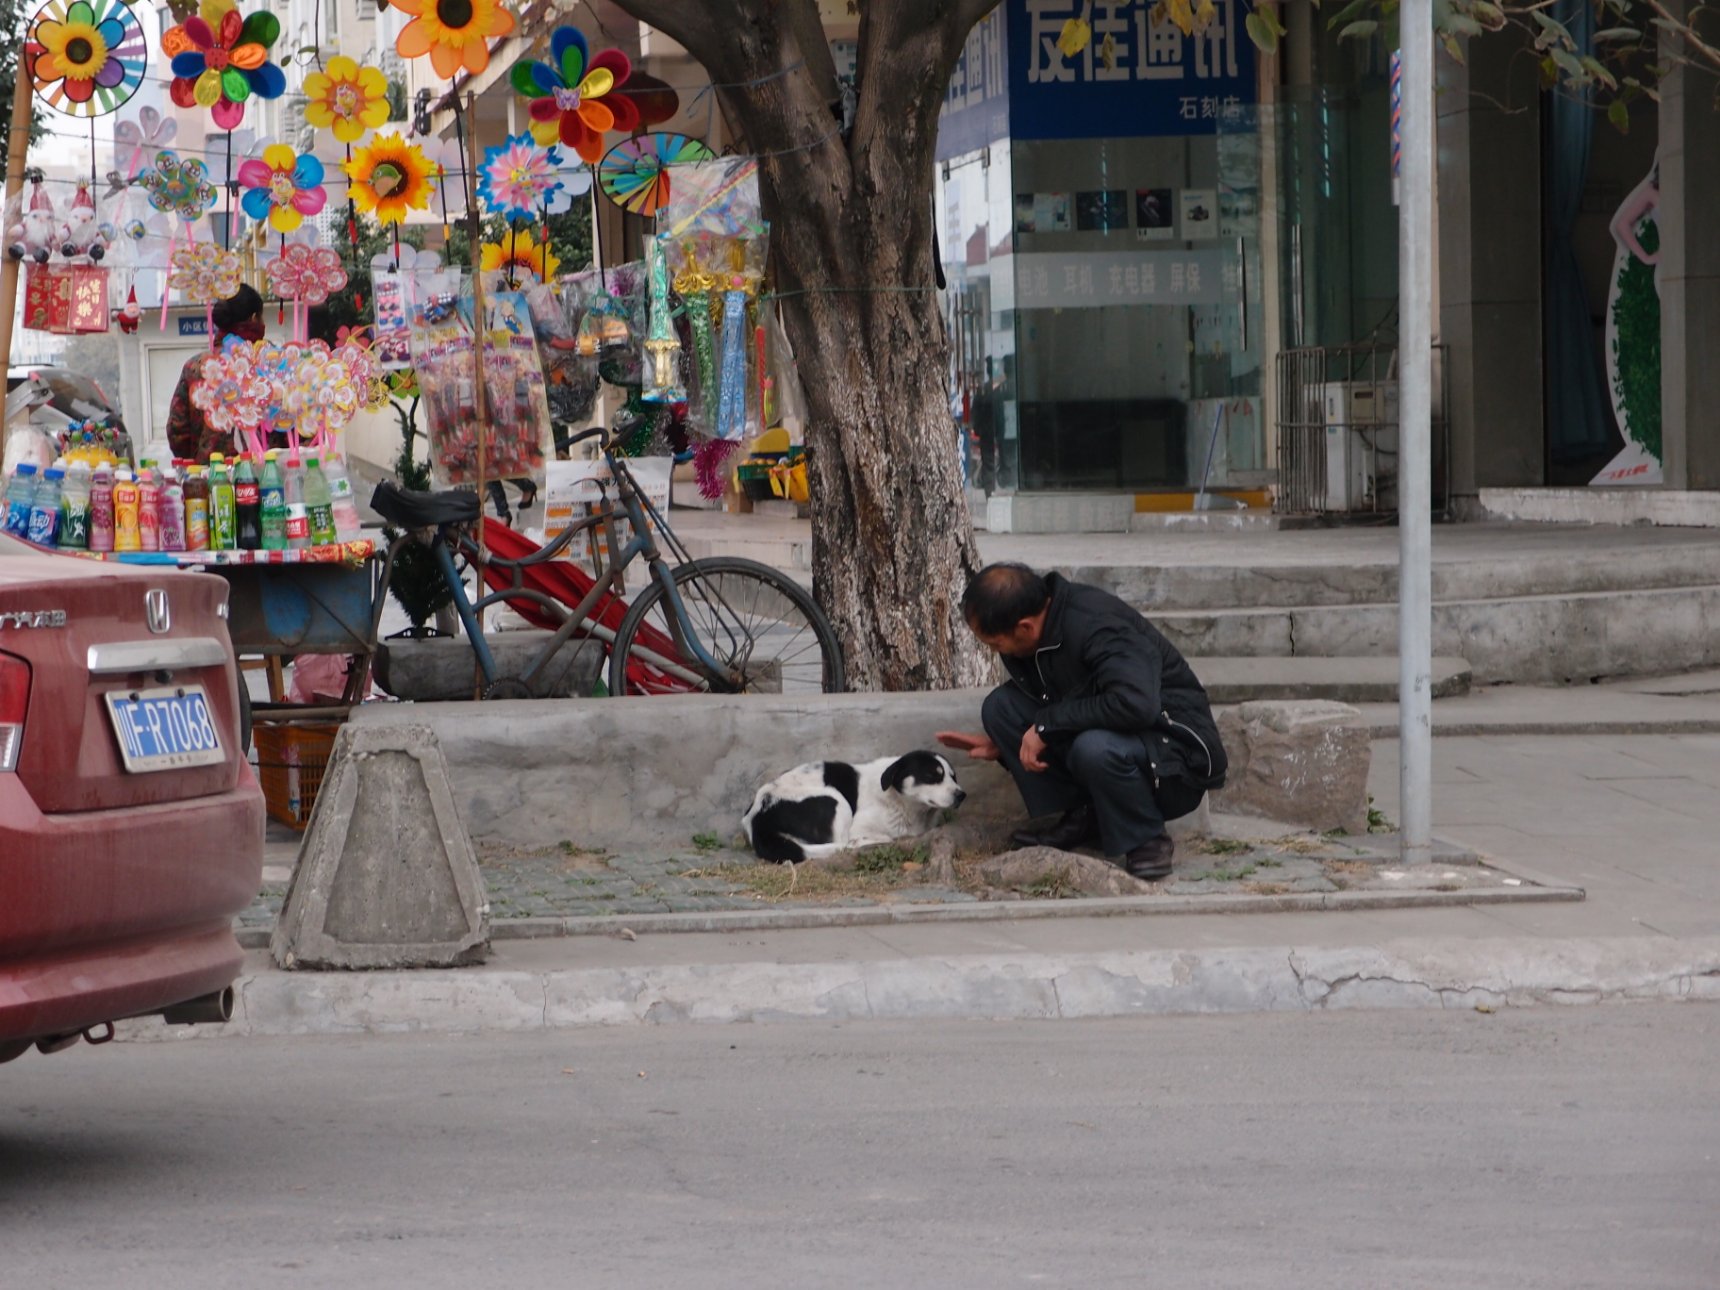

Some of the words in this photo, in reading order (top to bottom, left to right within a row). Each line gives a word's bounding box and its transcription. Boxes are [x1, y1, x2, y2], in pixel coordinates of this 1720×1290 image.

[1026, 0, 1238, 83] 友佳通讯
[1179, 96, 1241, 119] 石刻店
[1017, 266, 1049, 297] 电池
[1063, 265, 1095, 295] 耳机
[1108, 263, 1156, 295] 充电器
[1170, 262, 1201, 293] 屏保
